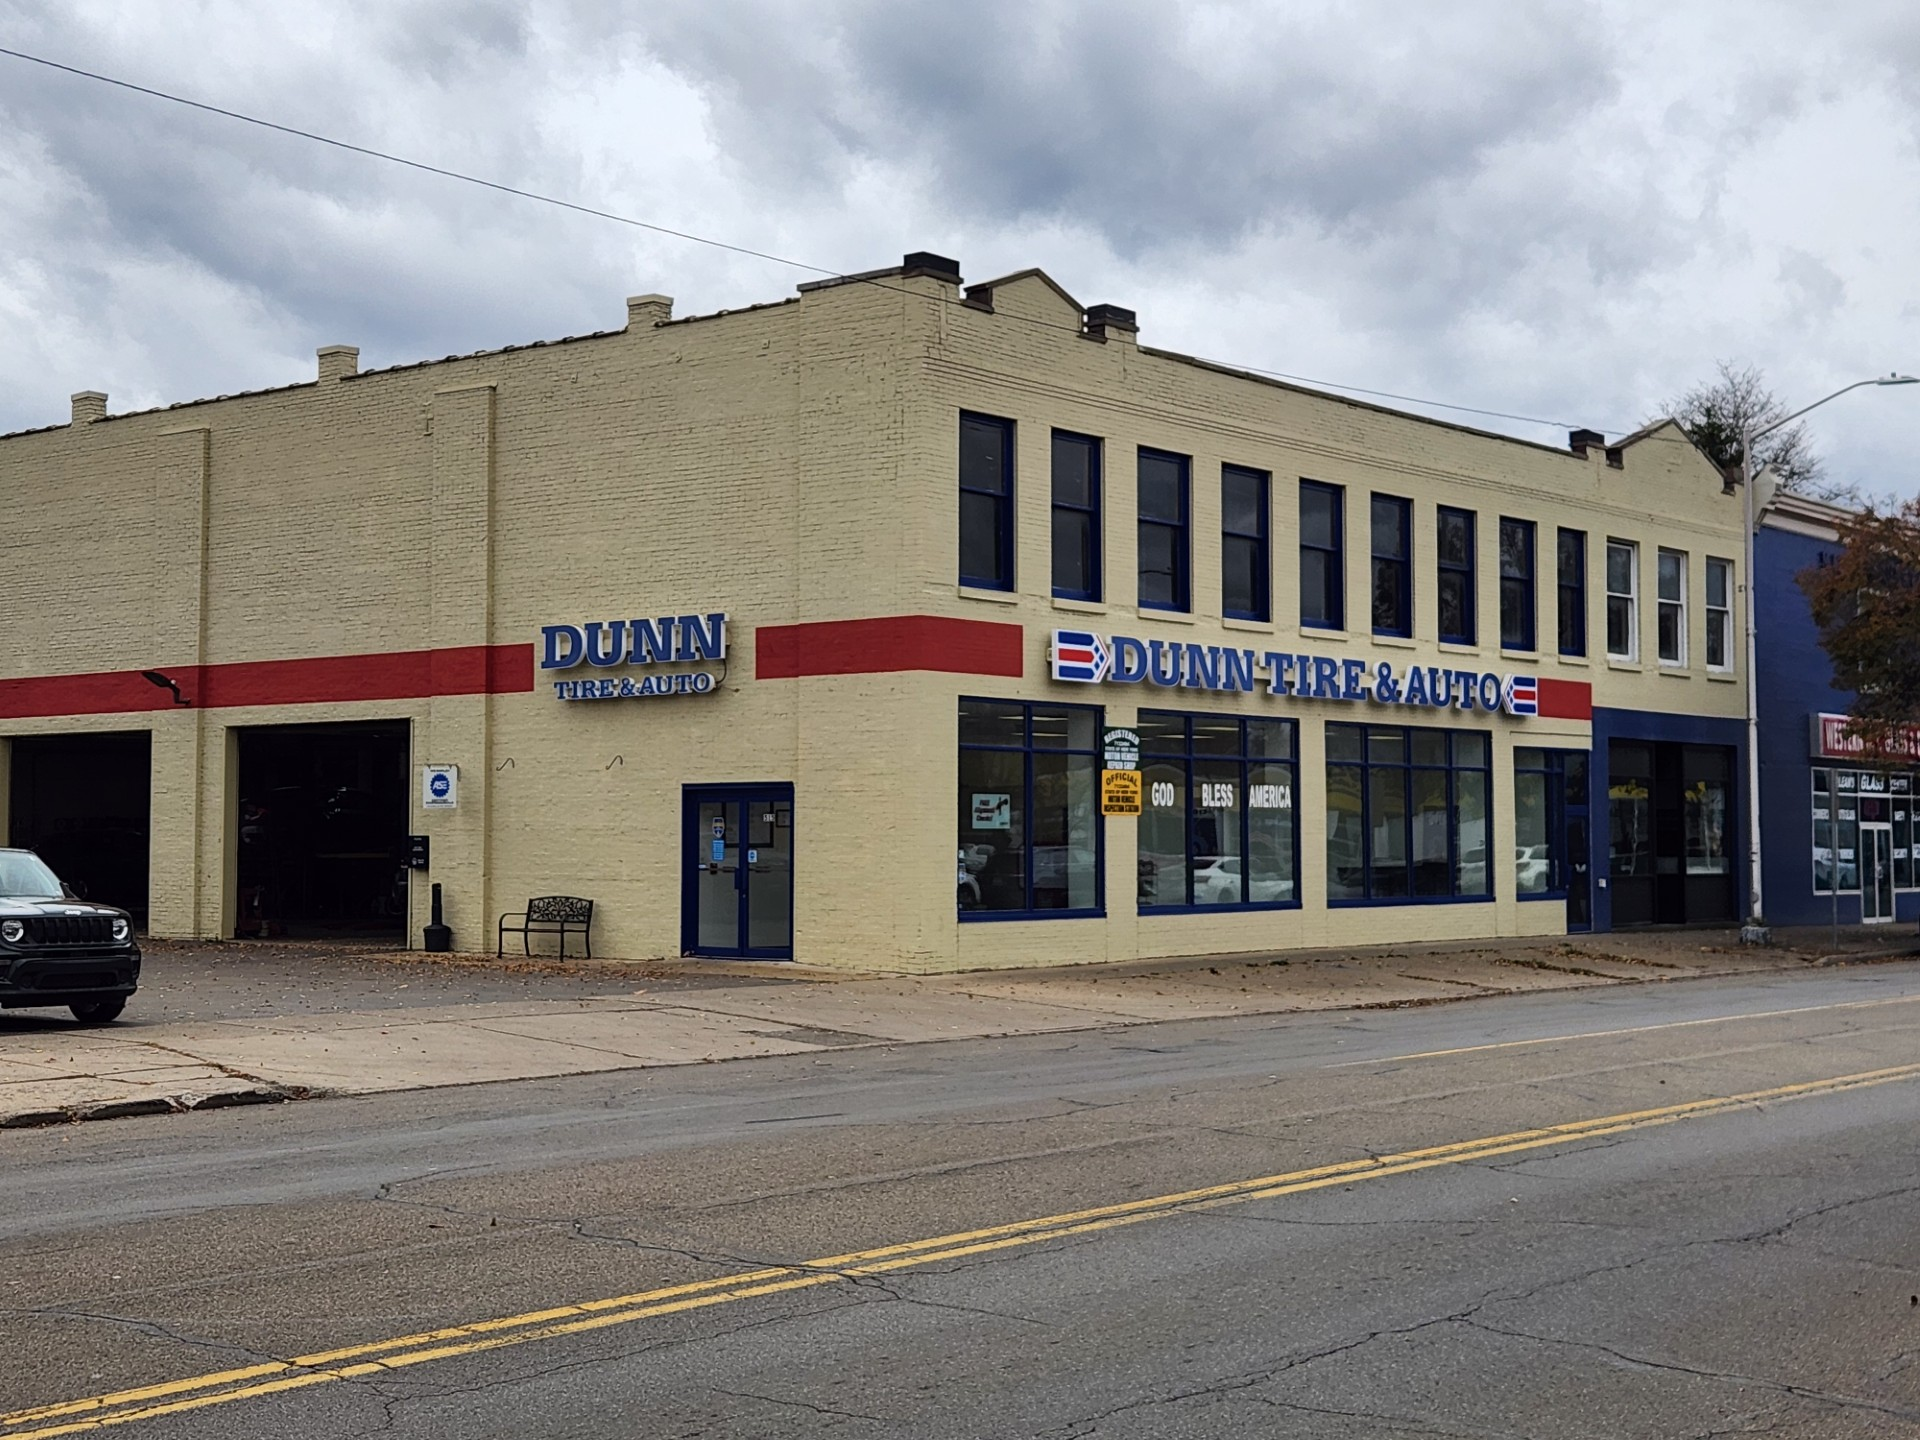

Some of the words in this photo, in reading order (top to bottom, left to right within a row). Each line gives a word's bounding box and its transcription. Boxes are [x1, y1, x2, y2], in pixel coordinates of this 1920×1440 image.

[541, 613, 728, 669] DUNN
[554, 678, 618, 700] TIRE
[620, 676, 637, 697] &
[638, 672, 715, 696] AUTO
[1108, 635, 1255, 692] DUNN
[1260, 652, 1367, 700] TIRE
[1373, 661, 1402, 704] &
[1404, 665, 1501, 712] AUTO
[1106, 772, 1138, 788] OFFICIAL
[1152, 782, 1174, 807] GOD
[1202, 783, 1233, 807] BLESS
[1249, 784, 1292, 808] AMERICA
